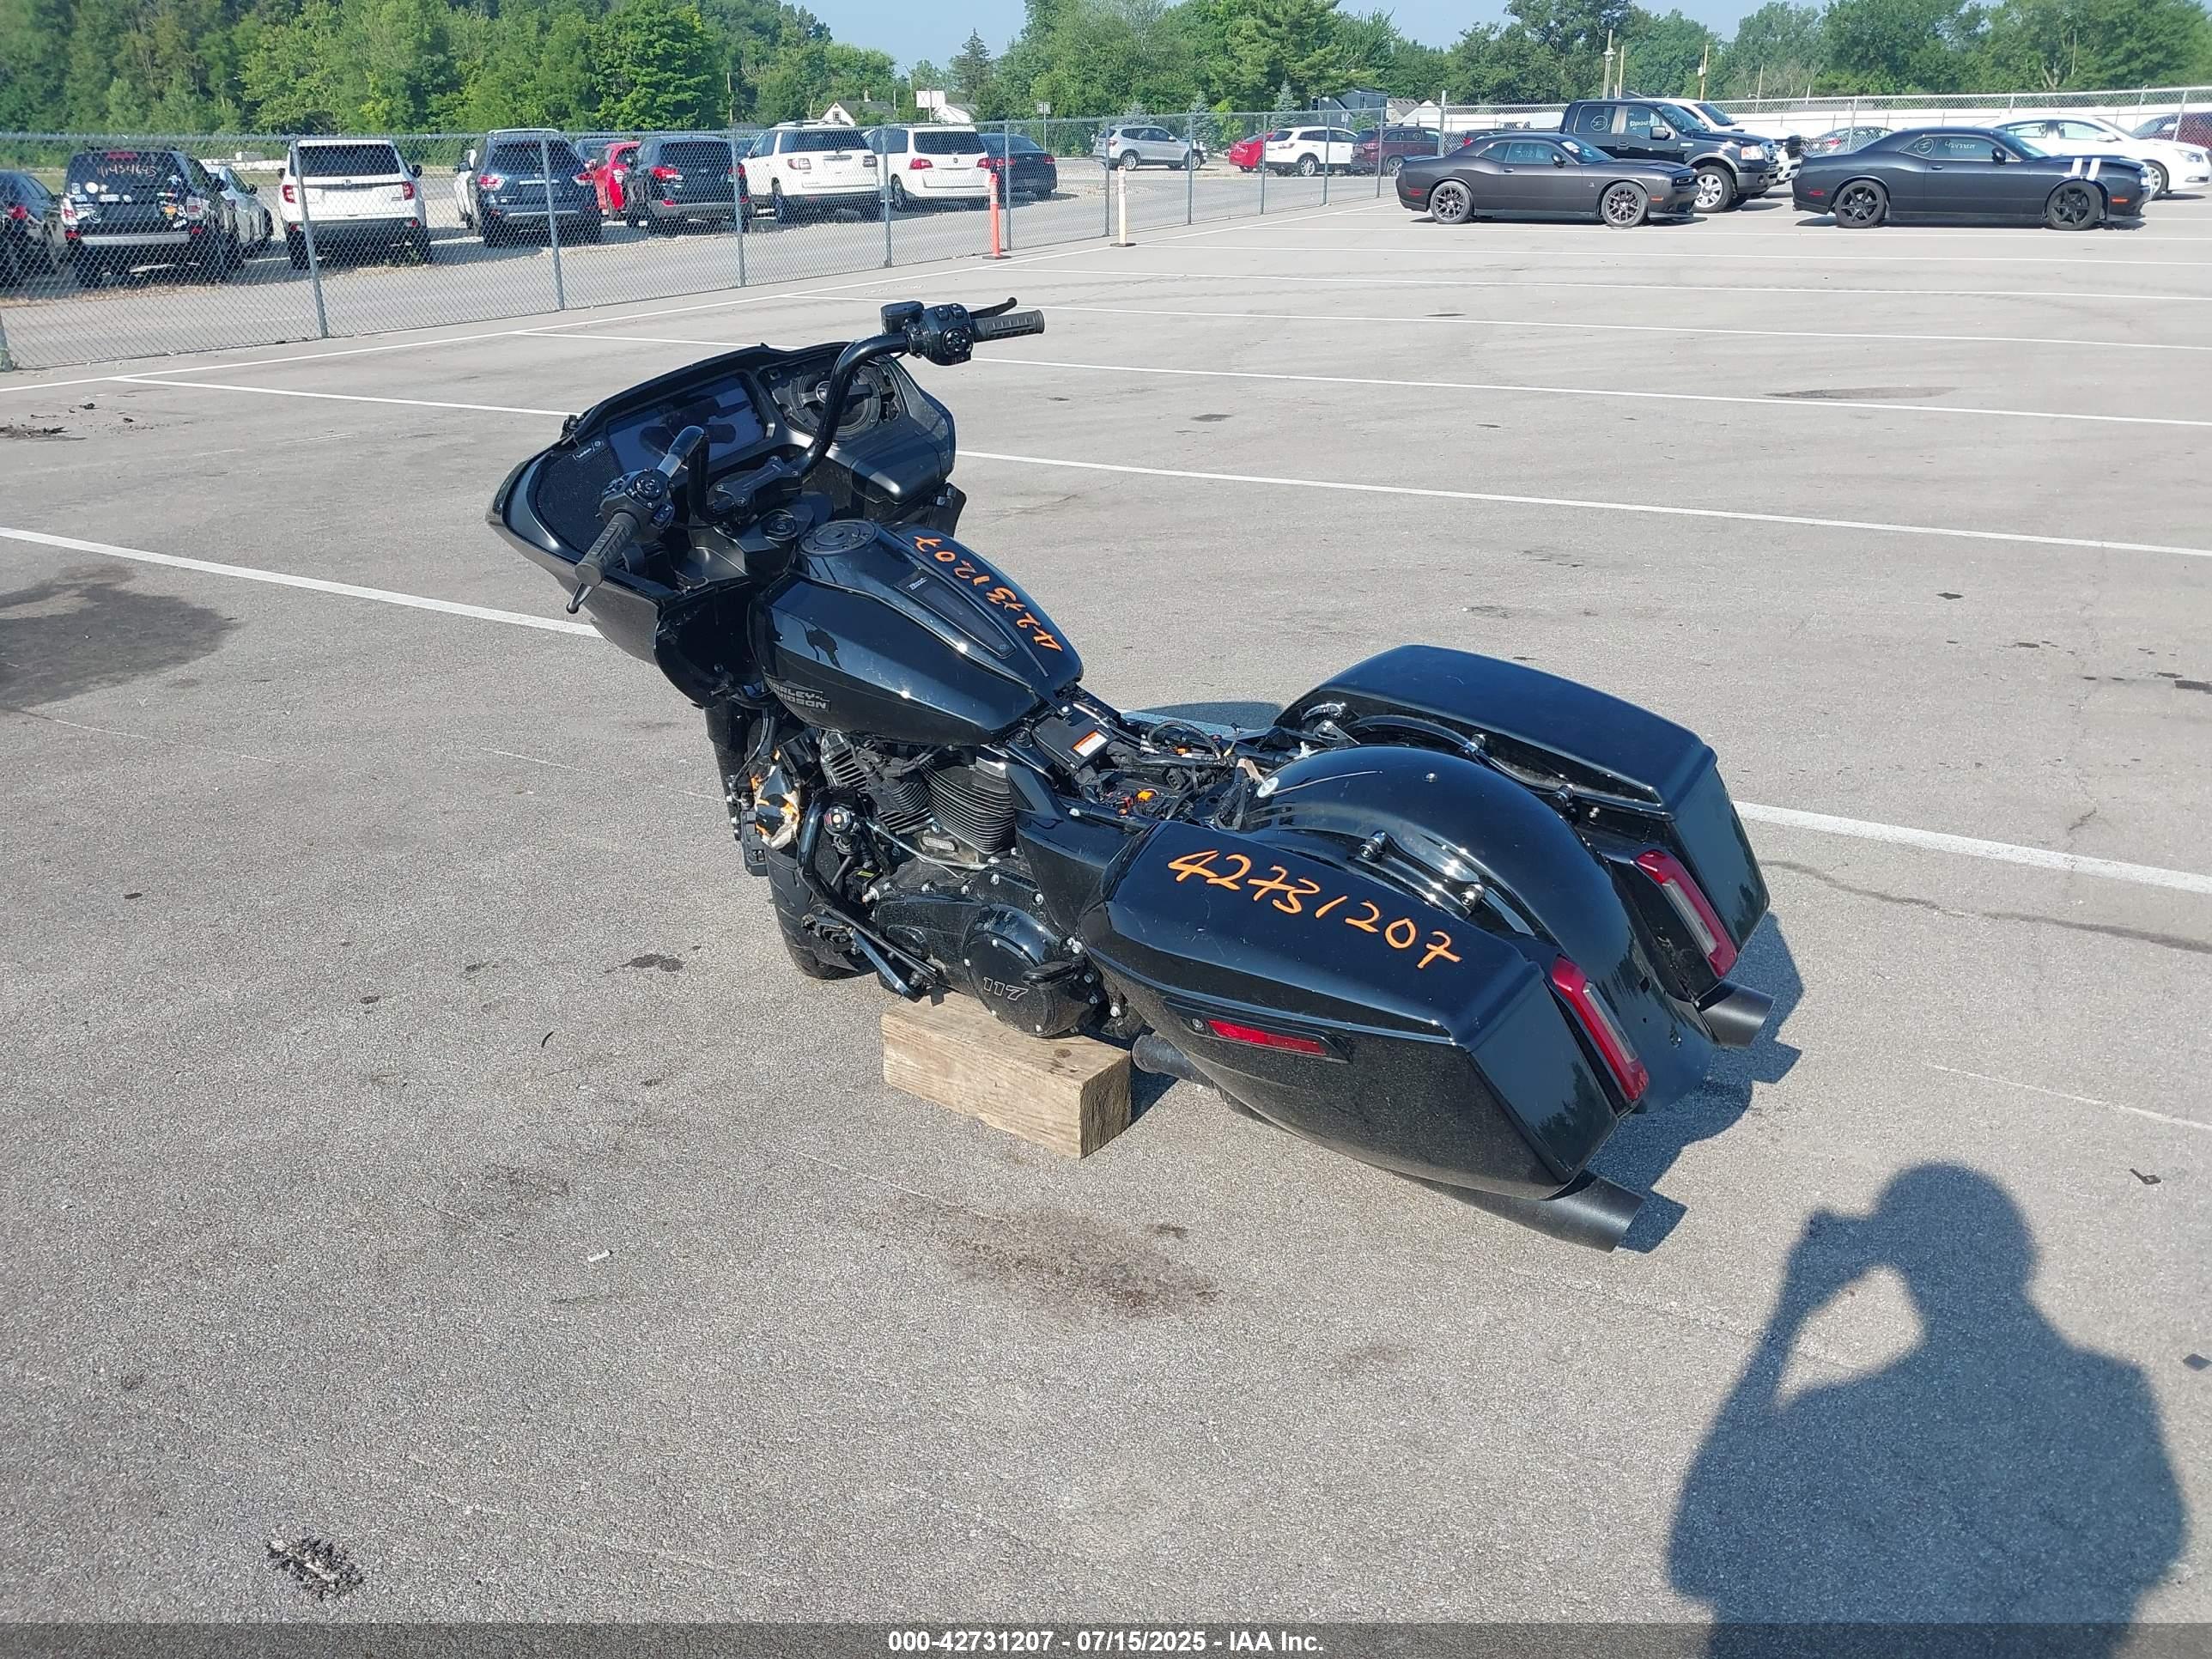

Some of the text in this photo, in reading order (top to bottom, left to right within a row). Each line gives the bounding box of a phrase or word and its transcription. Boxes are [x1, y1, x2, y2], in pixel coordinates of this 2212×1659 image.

[913, 536, 1063, 652] 42731207
[1168, 850, 1462, 969] 42731207
[983, 976, 1029, 1001] 117
